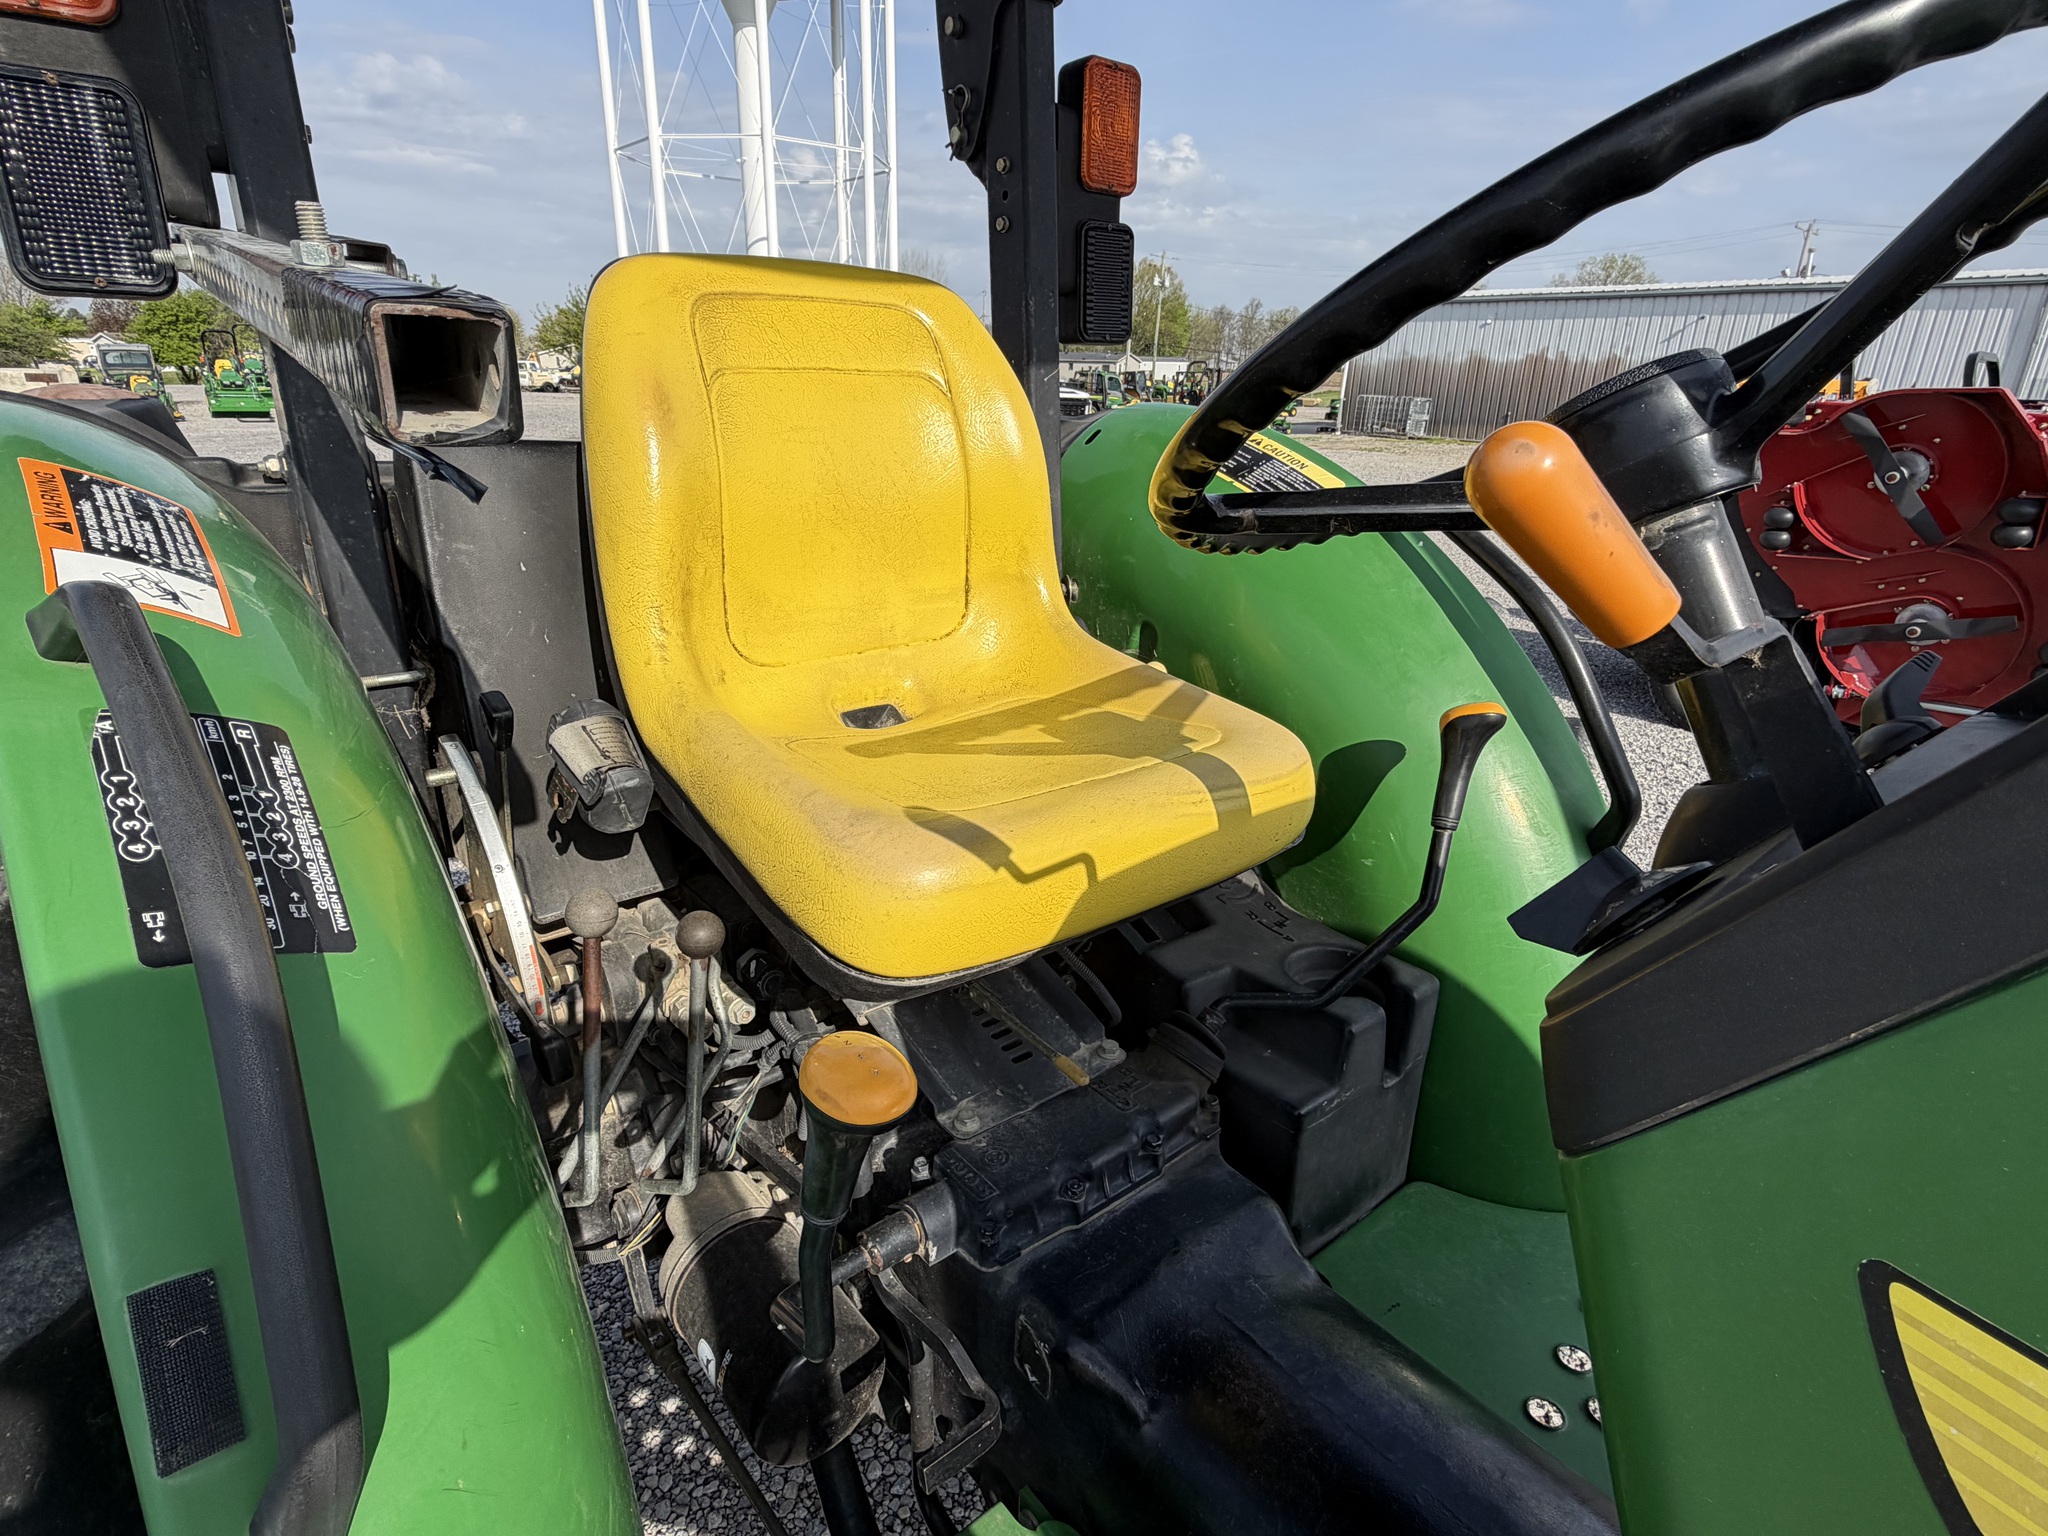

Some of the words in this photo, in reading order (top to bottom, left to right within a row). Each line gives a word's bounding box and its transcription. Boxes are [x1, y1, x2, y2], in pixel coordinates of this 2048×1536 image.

[1262, 443, 1309, 470] CAUTION
[33, 471, 67, 518] WARNING
[100, 506, 114, 528] Rollover
[86, 528, 105, 550] AVOID
[105, 528, 120, 545] Keep
[117, 521, 133, 547] Structure
[131, 531, 145, 542] not
[135, 541, 147, 551] Do
[149, 542, 161, 555] Use
[95, 720, 114, 732] A
[236, 728, 253, 739] R
[279, 745, 299, 774] TIRES)
[271, 756, 287, 778] RPM
[221, 773, 234, 781] 2
[258, 790, 274, 799] 1
[279, 779, 295, 802] 2300
[291, 776, 310, 808] 14.9-28
[117, 797, 135, 807] 2
[287, 803, 301, 817] AT
[266, 812, 282, 822] 2
[302, 810, 319, 836] WITH
[122, 820, 140, 830] 3
[272, 832, 288, 842] 3
[292, 818, 313, 860] SPEEDS
[128, 843, 146, 853] 4
[245, 850, 257, 861] 10
[277, 852, 293, 863] 4
[312, 838, 337, 892] EQUIPPED
[253, 876, 263, 887] 14
[305, 861, 328, 910] GROUND
[259, 894, 271, 907] 20
[329, 894, 350, 931] (WHEN
